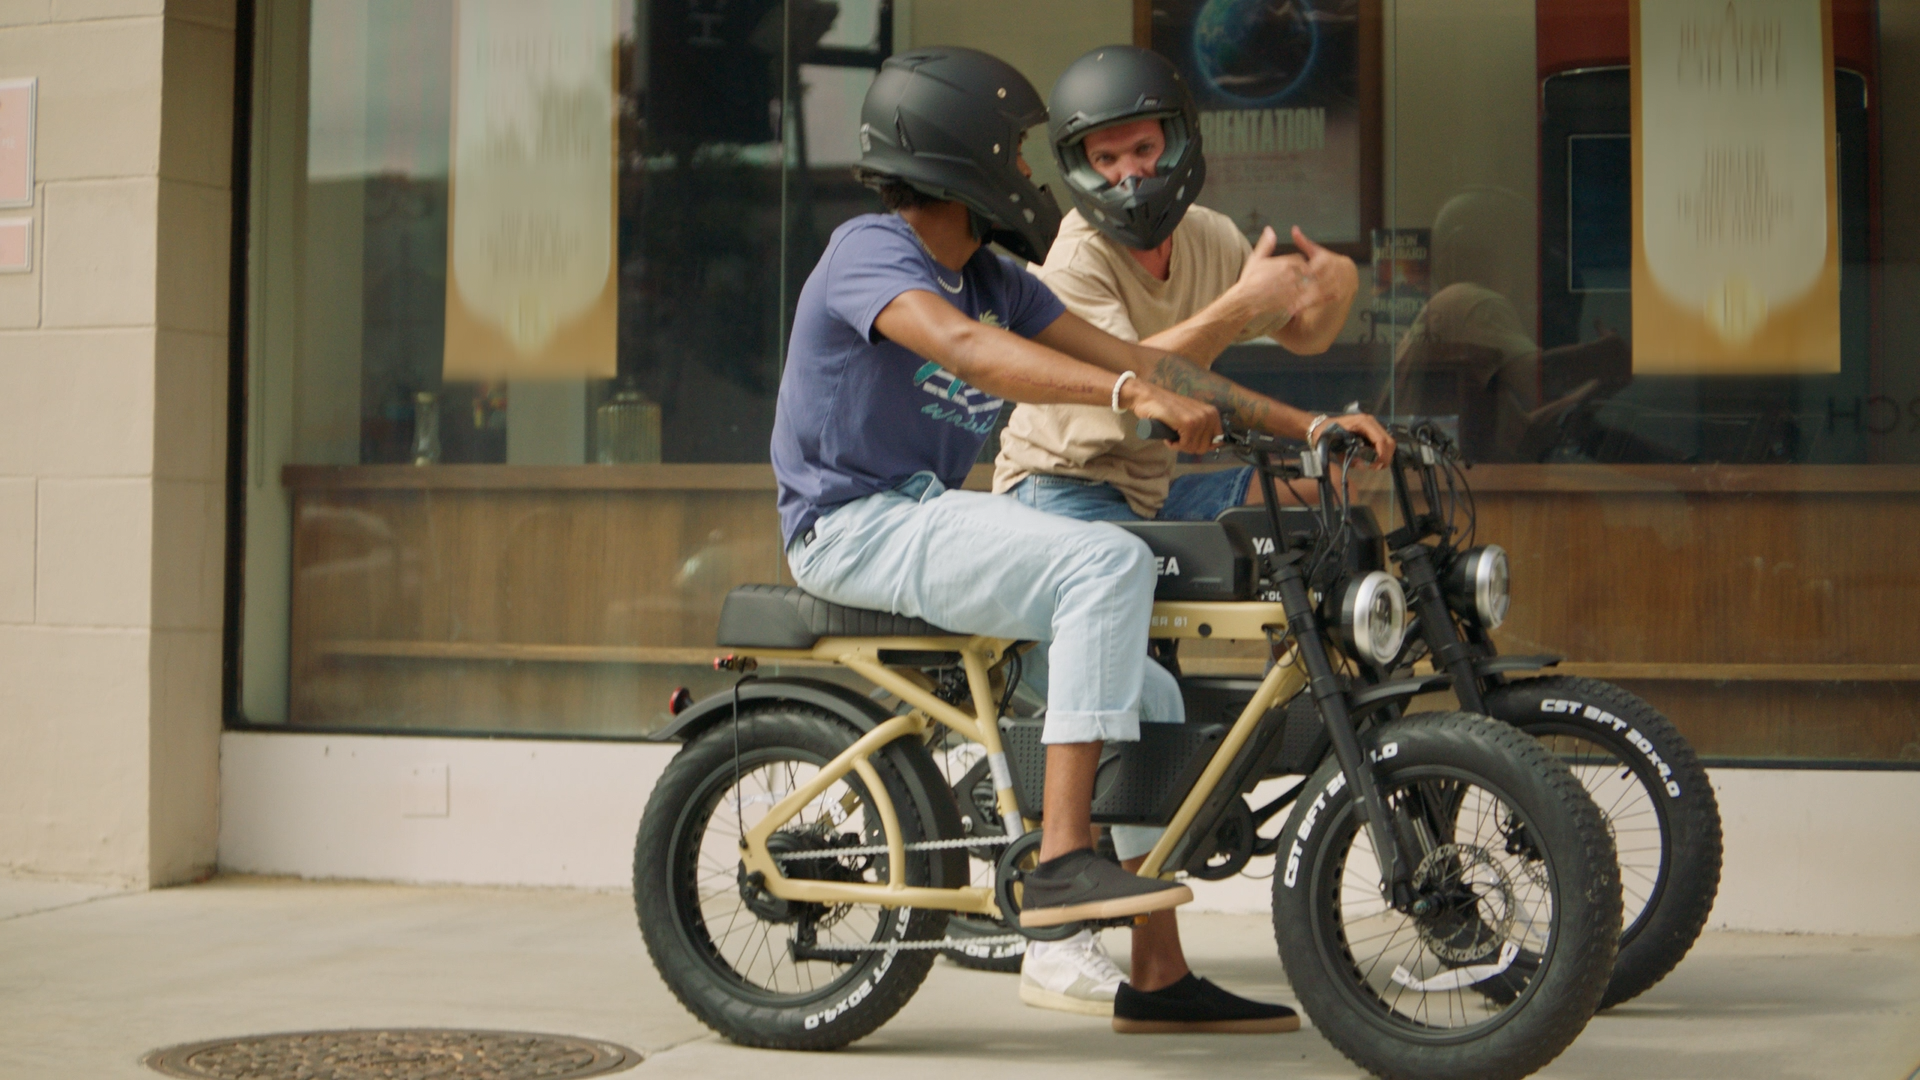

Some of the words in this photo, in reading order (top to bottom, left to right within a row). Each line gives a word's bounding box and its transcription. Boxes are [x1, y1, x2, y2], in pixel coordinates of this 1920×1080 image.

[1541, 699, 1582, 714] CST
[1583, 705, 1627, 731] BFT
[1284, 839, 1303, 888] CST
[1297, 792, 1326, 841] BFT
